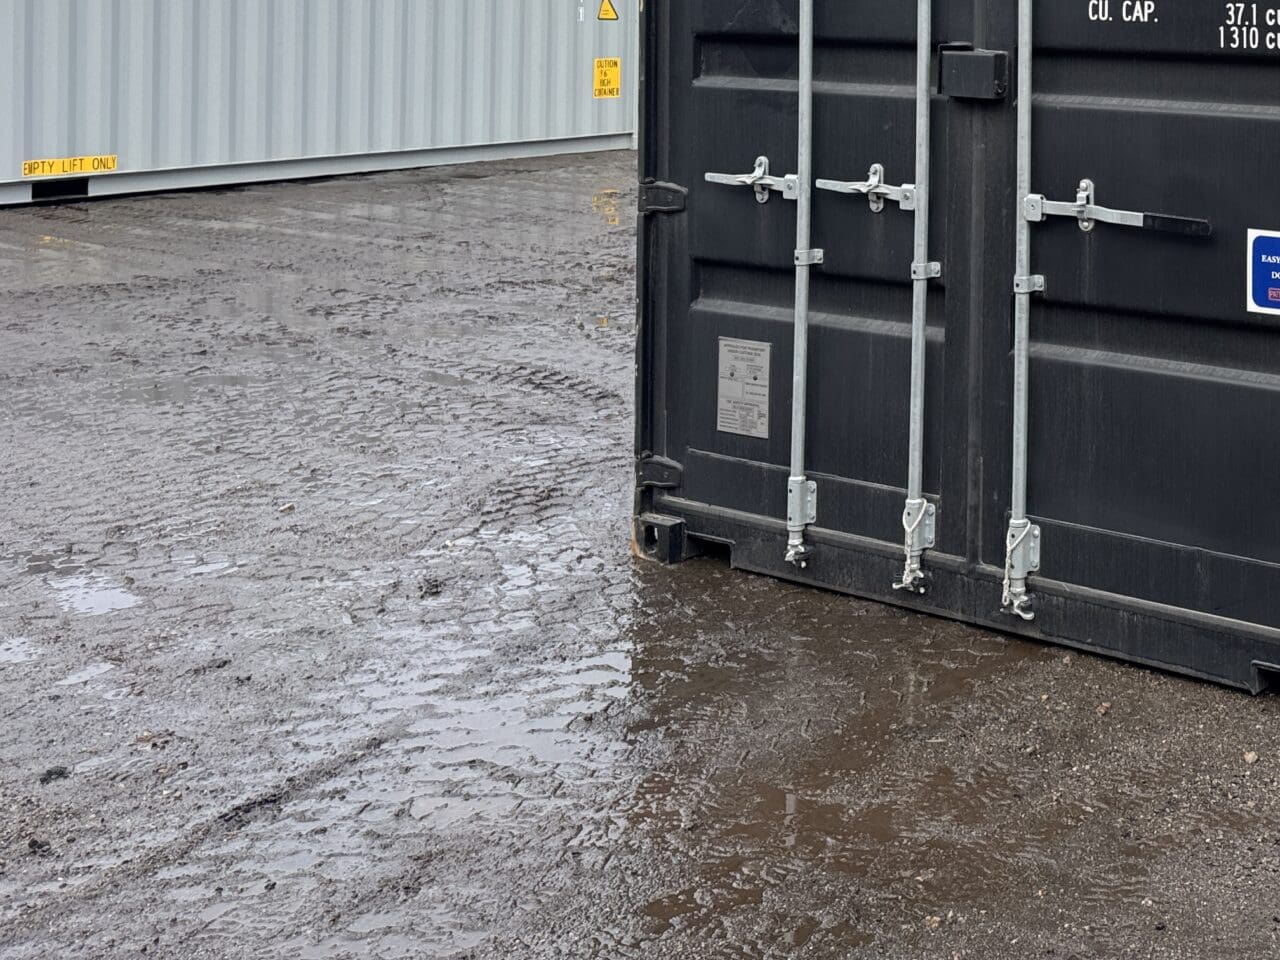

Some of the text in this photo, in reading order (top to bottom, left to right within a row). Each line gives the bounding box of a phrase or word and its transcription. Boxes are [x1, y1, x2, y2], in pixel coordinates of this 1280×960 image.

[1088, 0, 1113, 22] CU.
[1122, 0, 1159, 23] CAP.
[1225, 3, 1257, 26] 37.1
[23, 156, 117, 176] EMPTY LIFT ONLY
[1261, 254, 1280, 264] EASY
